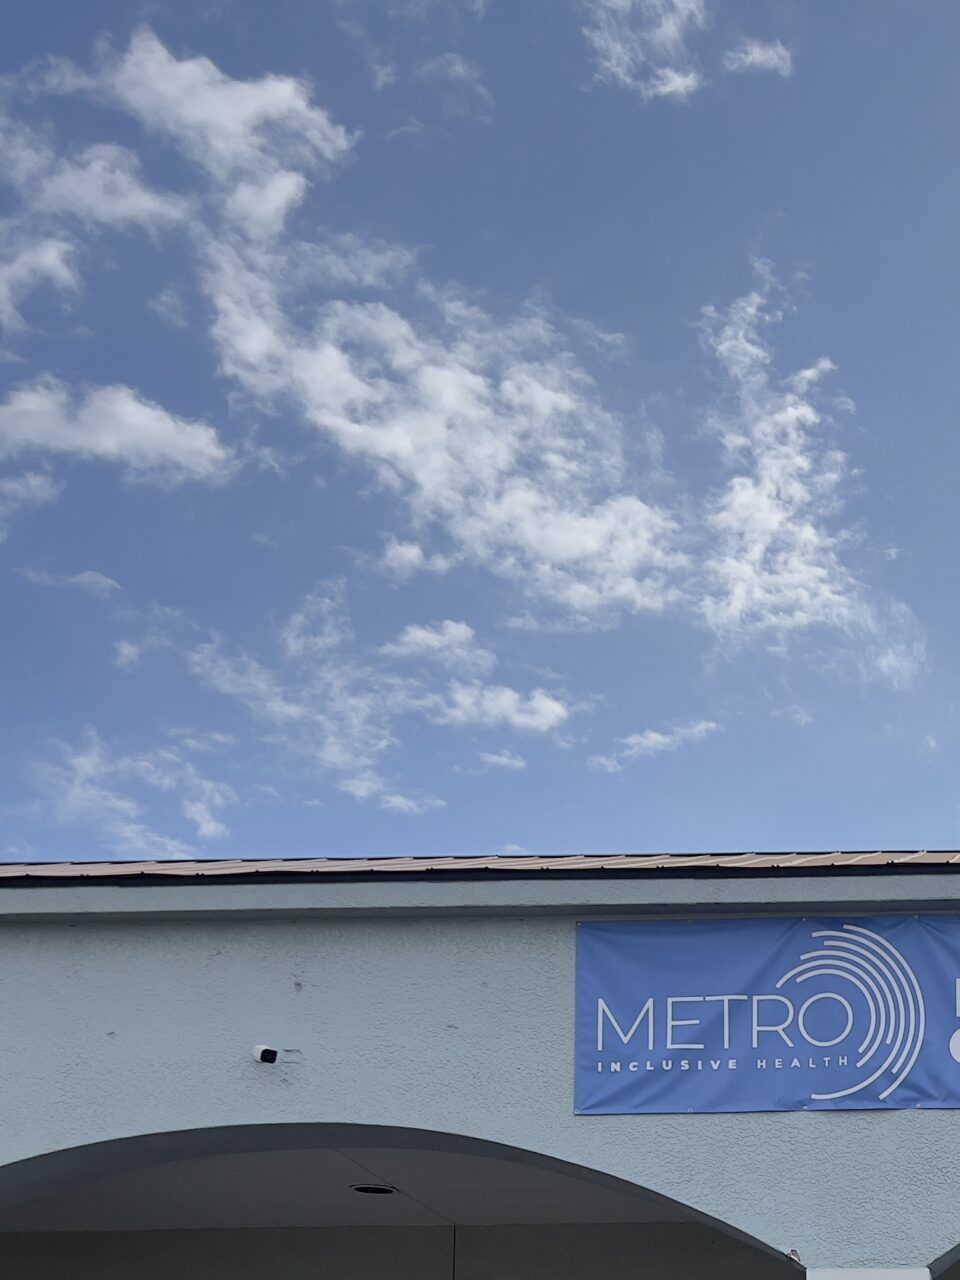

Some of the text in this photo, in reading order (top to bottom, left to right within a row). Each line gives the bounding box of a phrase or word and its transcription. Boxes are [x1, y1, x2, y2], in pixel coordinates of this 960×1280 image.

[596, 991, 853, 1051] METRO
[597, 1055, 849, 1072] INCLUSIVE HEALTH
